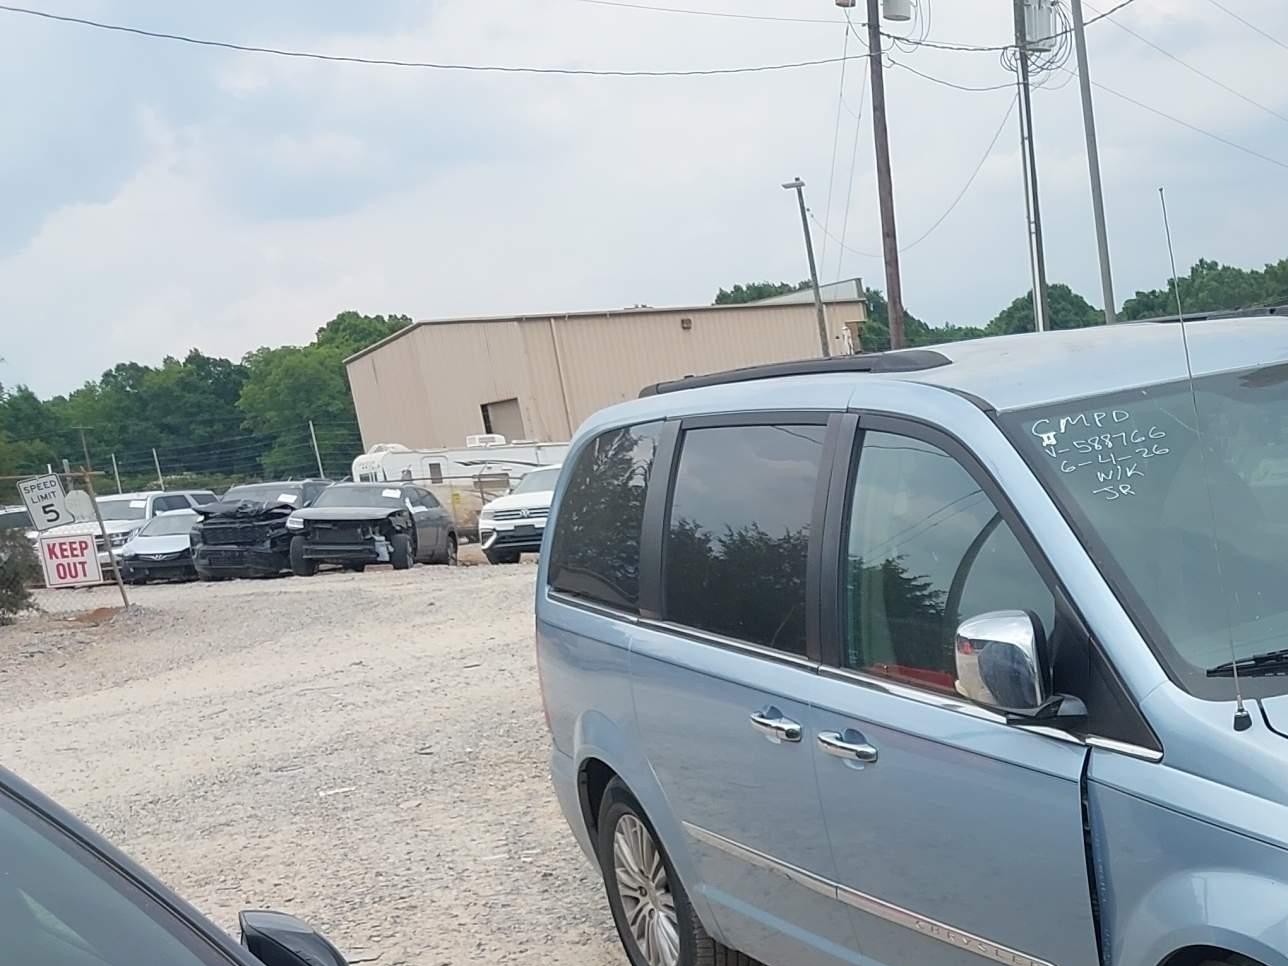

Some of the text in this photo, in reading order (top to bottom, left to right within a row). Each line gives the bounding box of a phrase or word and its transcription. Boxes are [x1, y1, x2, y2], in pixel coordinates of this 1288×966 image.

[23, 480, 57, 494] SPEED
[31, 491, 57, 504] LIMIT
[42, 503, 60, 523] 5
[47, 540, 89, 560] KEEP
[56, 561, 87, 580] OUT
